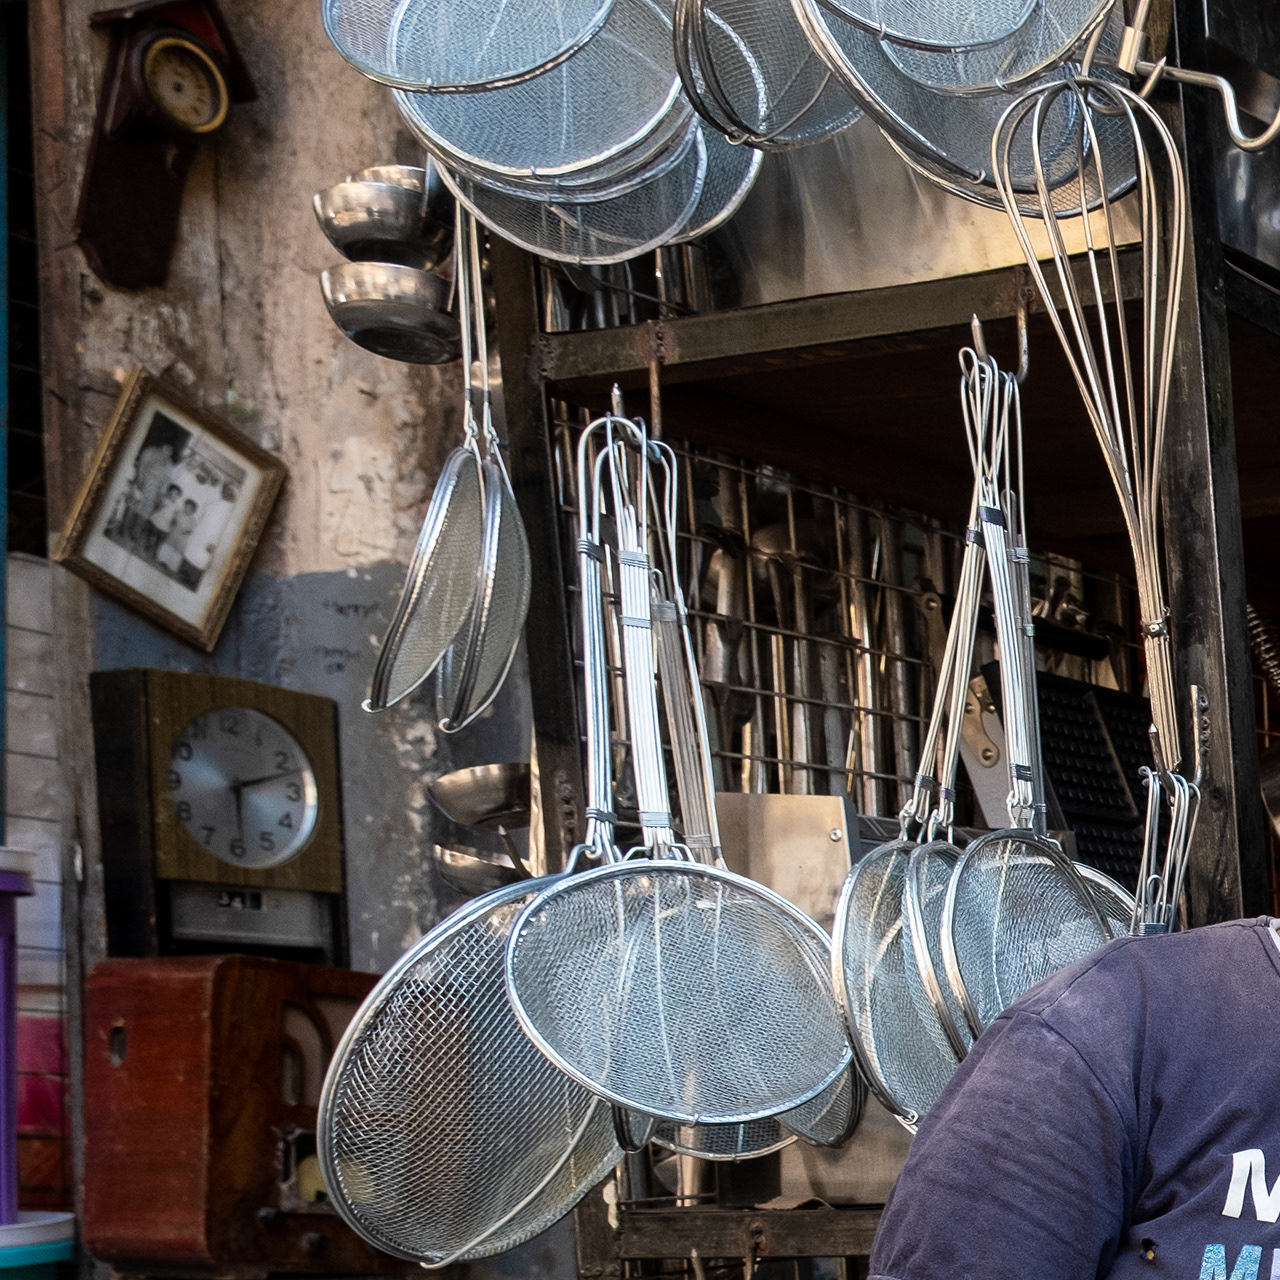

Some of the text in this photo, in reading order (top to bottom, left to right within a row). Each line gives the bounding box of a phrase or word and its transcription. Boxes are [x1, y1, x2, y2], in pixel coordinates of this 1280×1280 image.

[274, 750, 289, 771] 2
[285, 781, 301, 803] 3
[176, 800, 193, 823] 8
[278, 812, 293, 830] 4
[201, 825, 216, 846] 7
[259, 831, 276, 852] 5
[229, 837, 247, 859] 6
